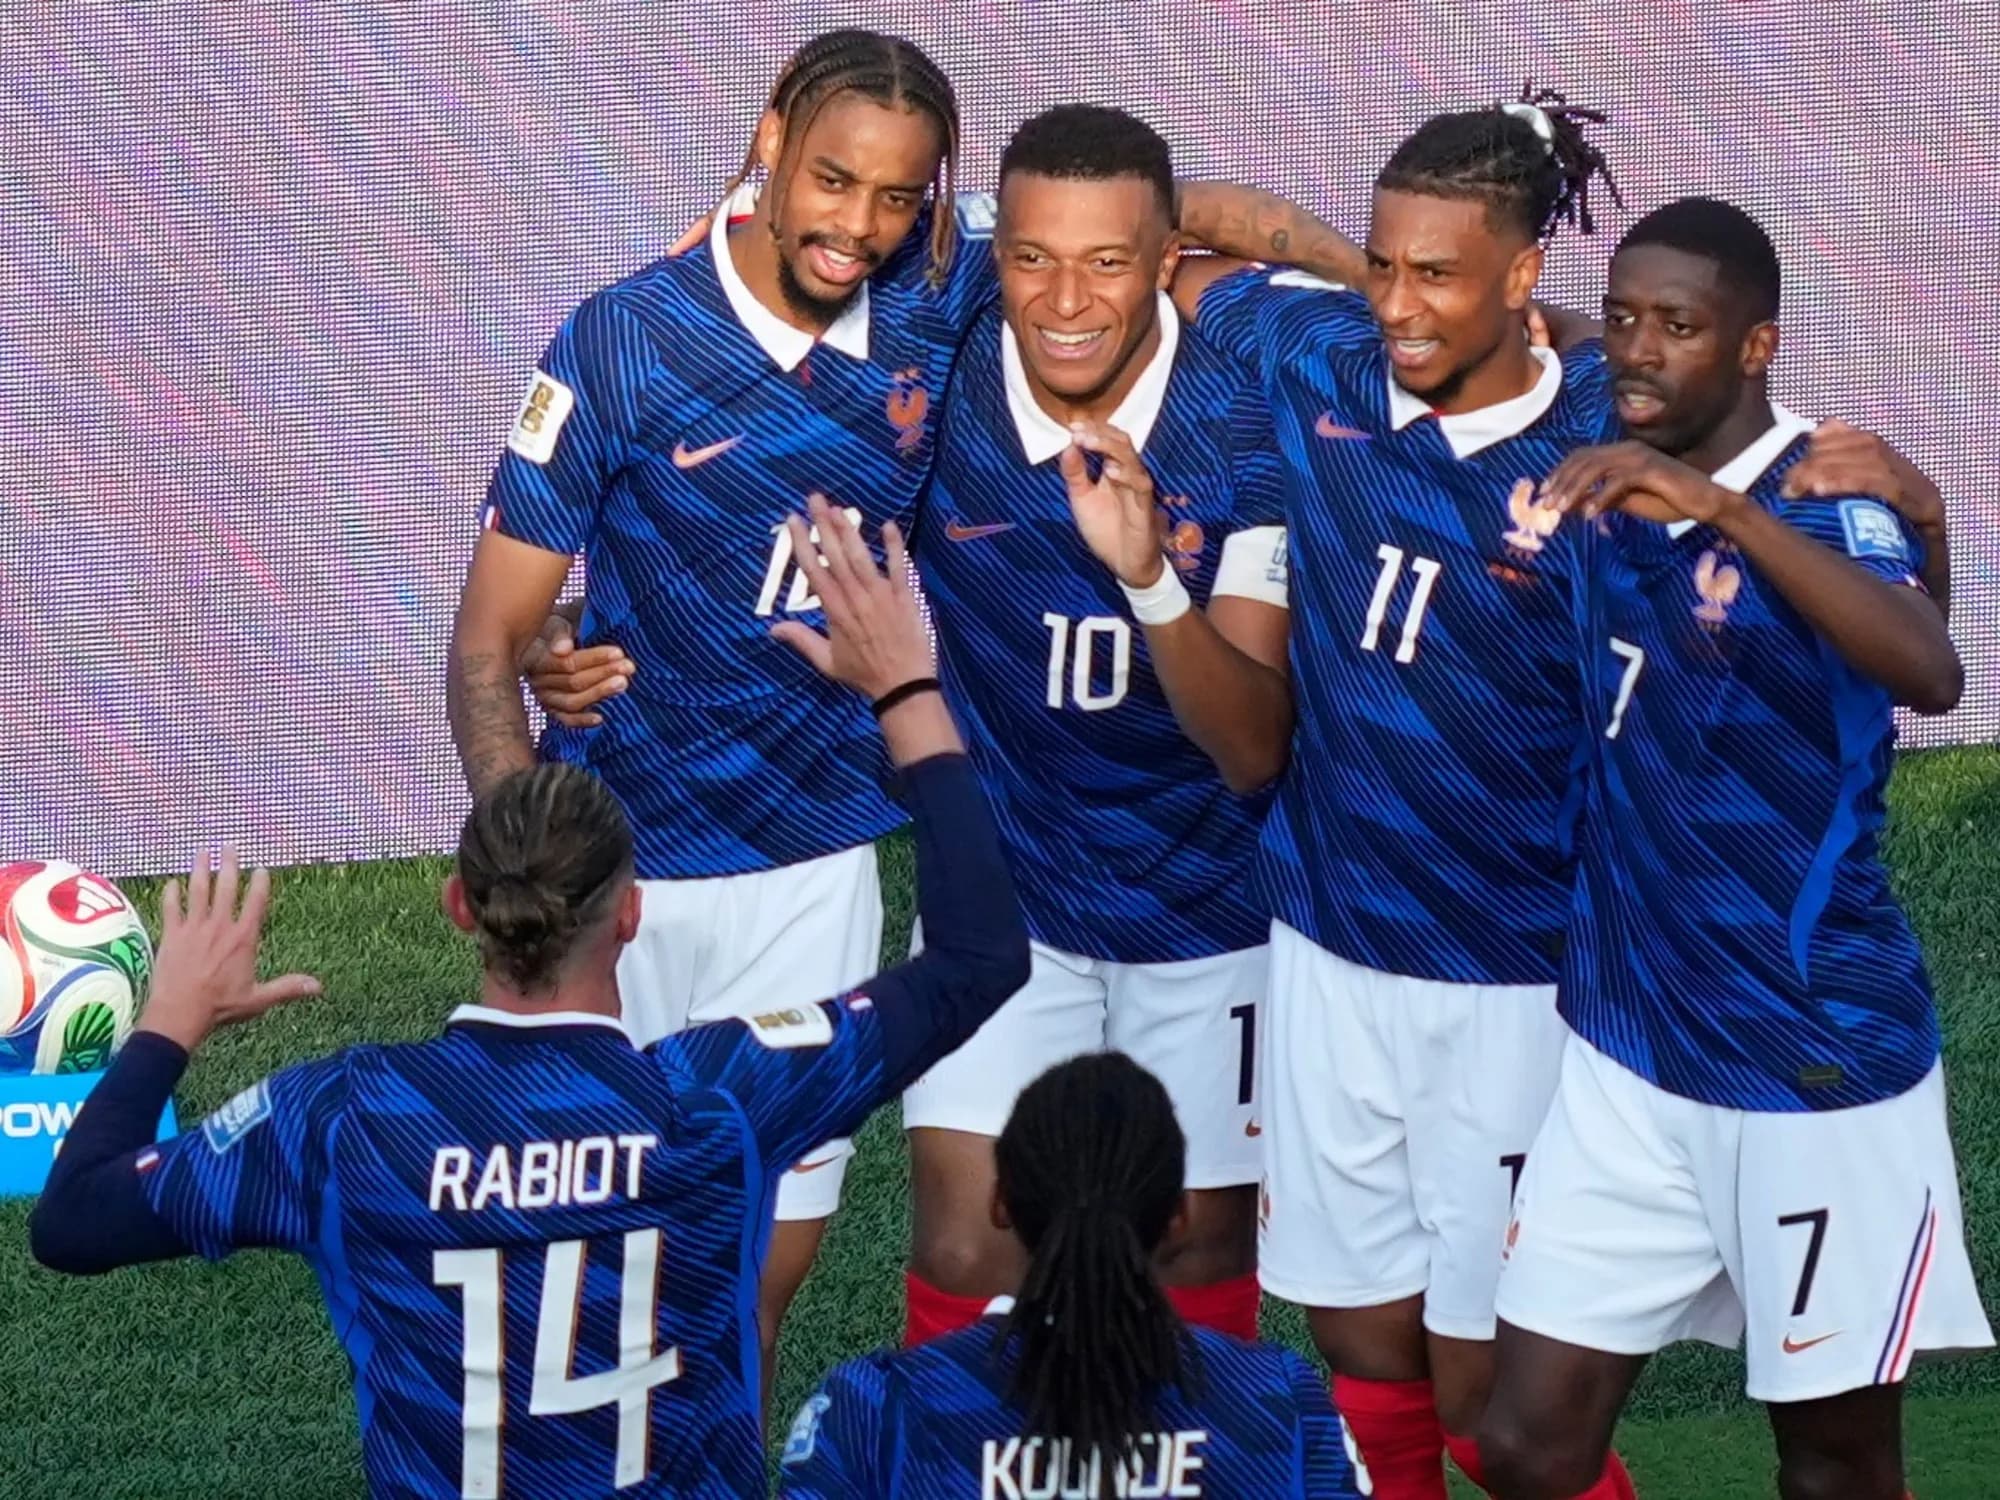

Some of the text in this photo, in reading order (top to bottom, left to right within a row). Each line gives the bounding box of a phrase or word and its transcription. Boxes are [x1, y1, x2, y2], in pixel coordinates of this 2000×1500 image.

[1360, 543, 1441, 664] 11
[1043, 612, 1131, 711] 10
[1605, 637, 1644, 739] 7
[1229, 1003, 1256, 1105] 1
[0, 1102, 84, 1138] OW
[429, 1134, 657, 1211] RABIOT
[1778, 1208, 1828, 1316] 7
[432, 1228, 683, 1500] 14
